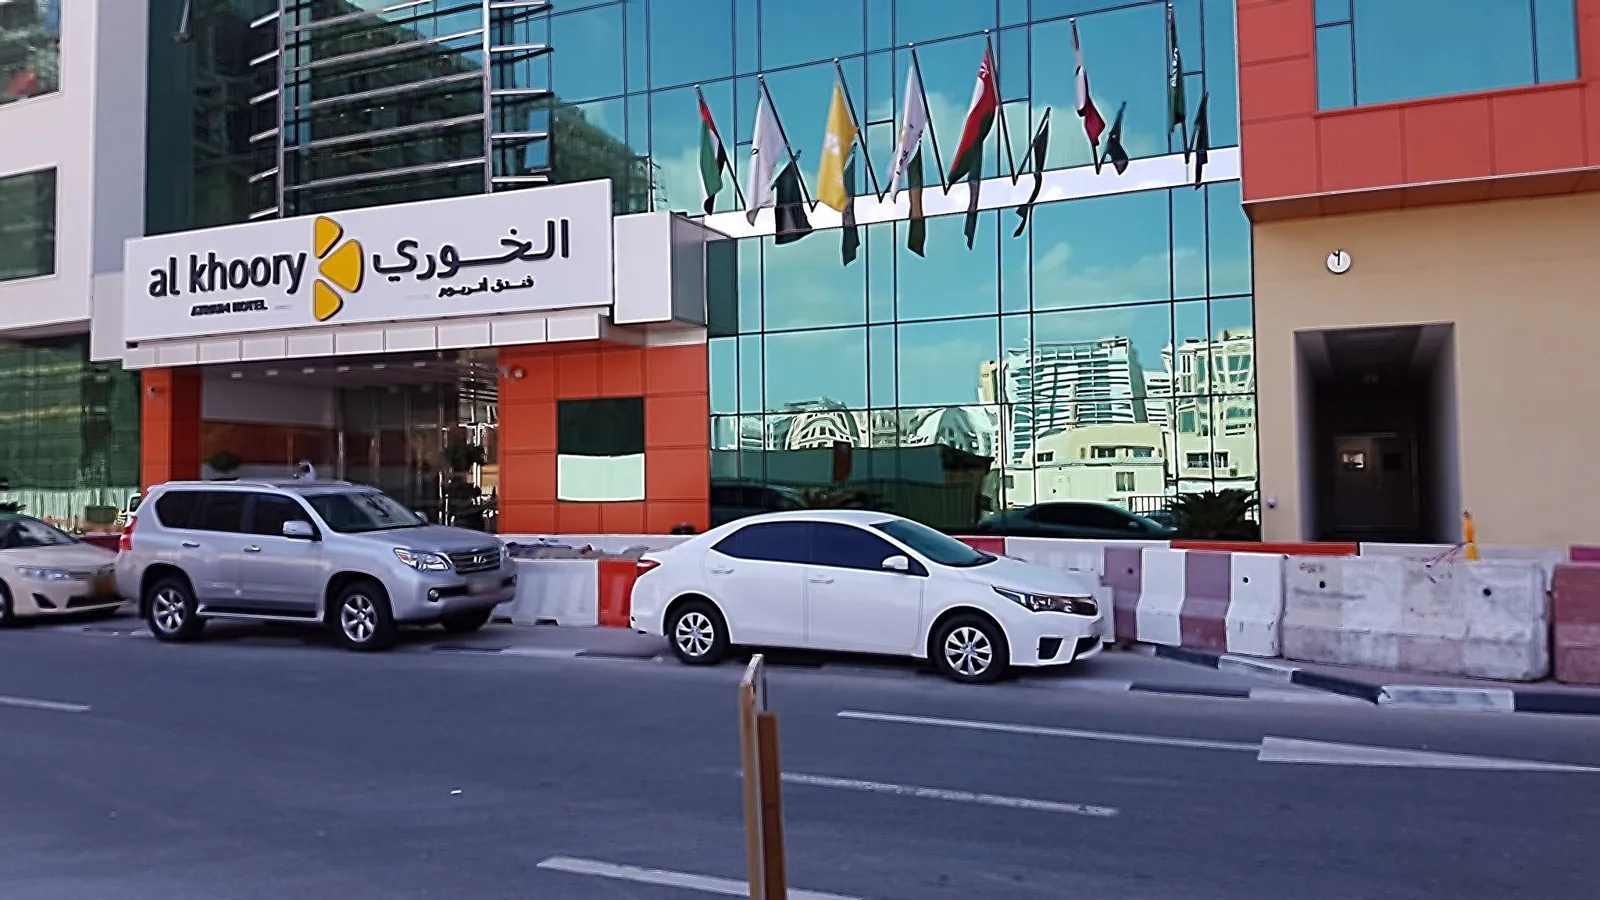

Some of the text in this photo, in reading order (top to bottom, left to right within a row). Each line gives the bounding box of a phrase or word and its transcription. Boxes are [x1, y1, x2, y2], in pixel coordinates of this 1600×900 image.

[150, 252, 307, 298] al khoory
[373, 219, 570, 283] الخوري
